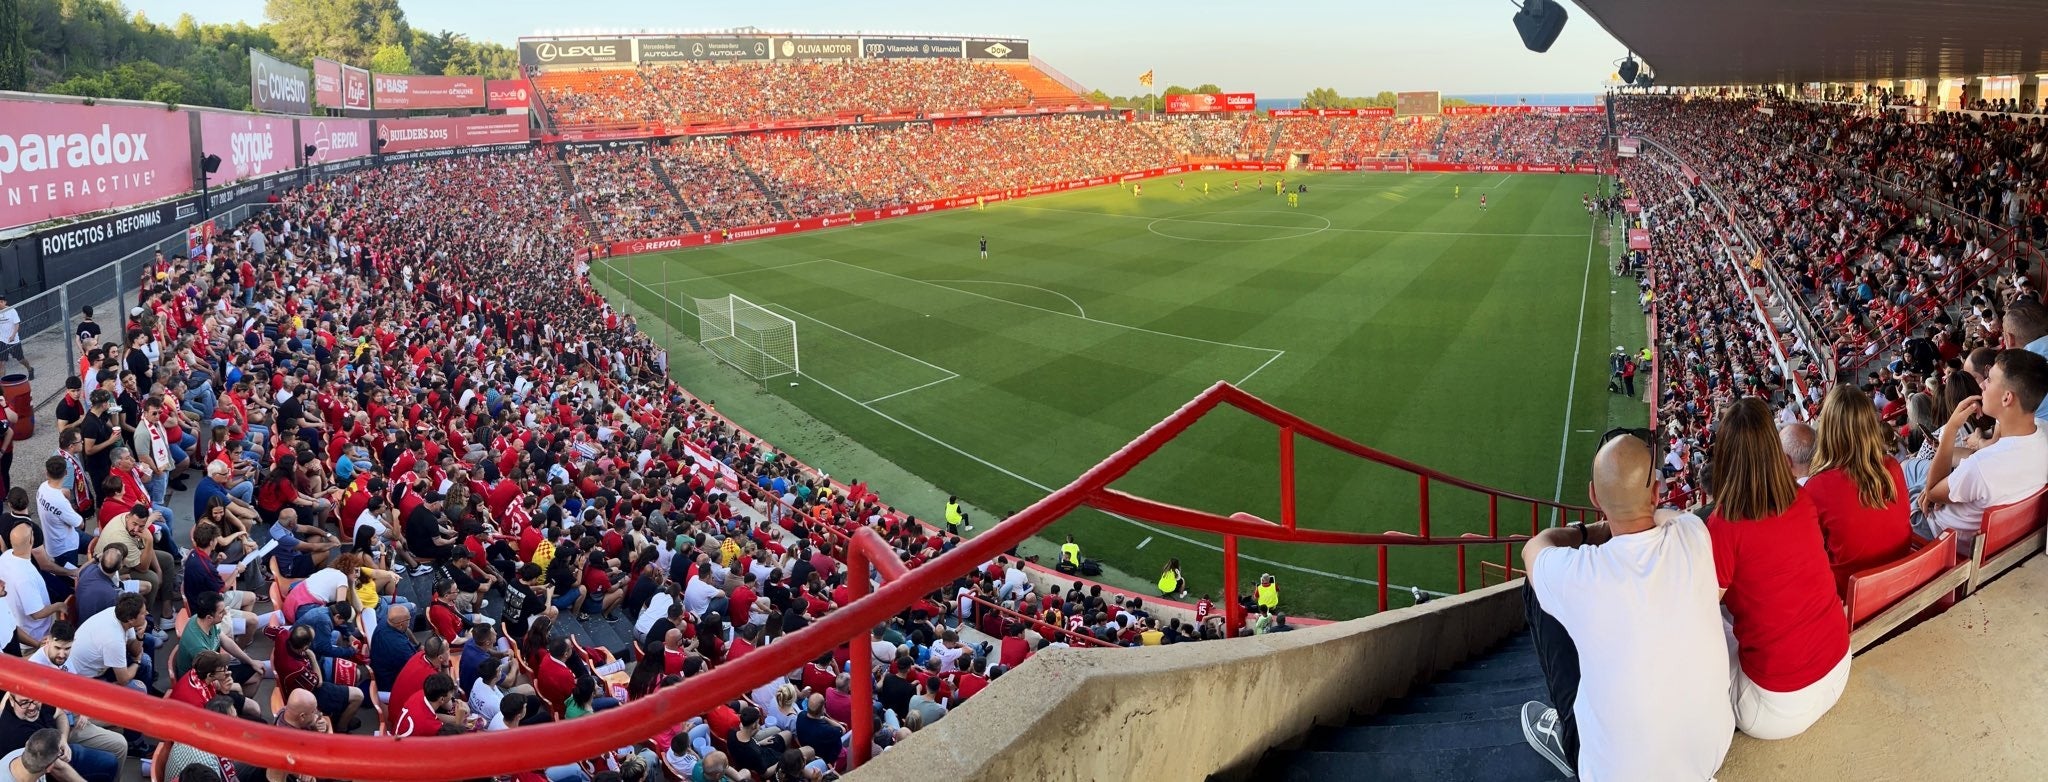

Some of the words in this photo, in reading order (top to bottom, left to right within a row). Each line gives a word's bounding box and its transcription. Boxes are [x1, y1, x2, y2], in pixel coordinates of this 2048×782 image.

[559, 46, 616, 56] LEXUS
[797, 45, 822, 53] OLIVA
[823, 44, 852, 53] MOTOR
[269, 73, 306, 103] covestro
[387, 79, 408, 93] BASF
[332, 131, 359, 150] REPSOL
[390, 128, 428, 141] BUILDERS
[429, 128, 448, 140] 2015
[0, 124, 149, 186] paradox
[420, 149, 453, 157] ACNDICIONADO
[457, 147, 489, 155] ELECTRICIDAD
[42, 229, 104, 256] ROYECTOS
[107, 223, 113, 238] &
[116, 210, 161, 235] REFORMAS
[734, 229, 759, 238] ESTRELLA
[759, 226, 776, 235] DAMM
[646, 239, 682, 250] REPSOL
[1199, 605, 1206, 615] 15
